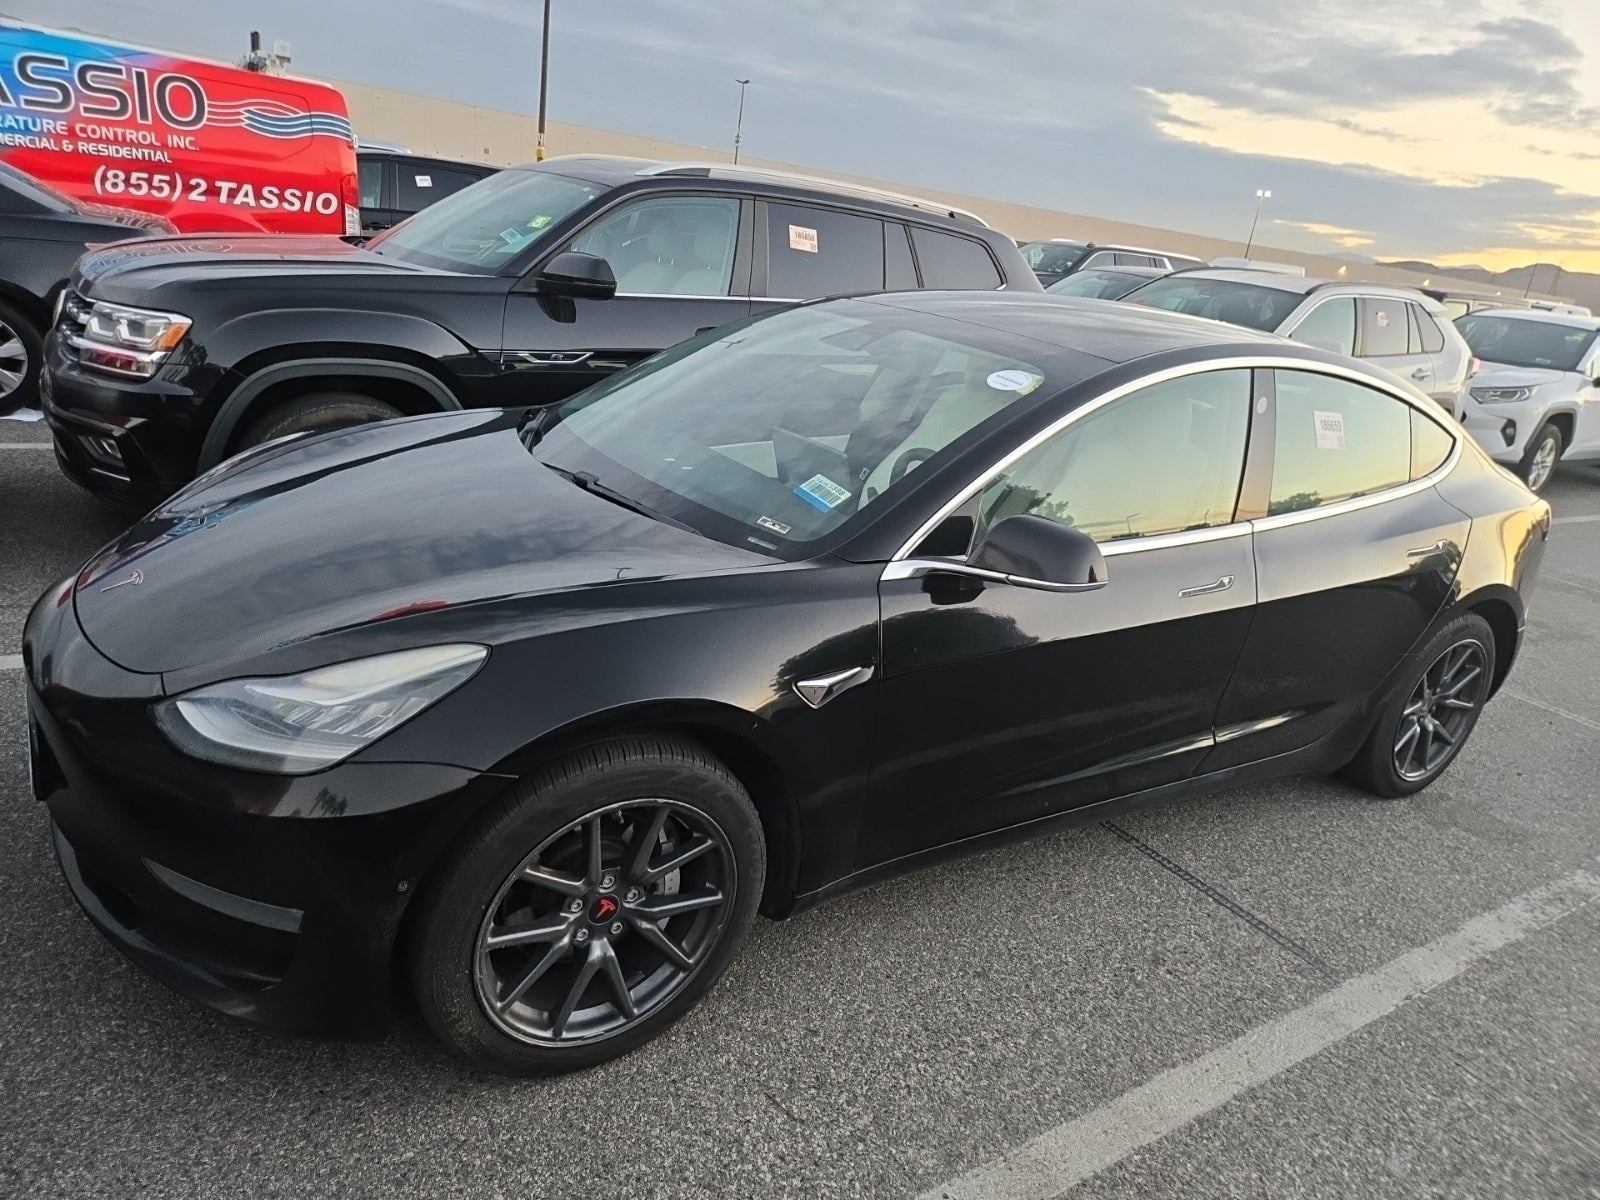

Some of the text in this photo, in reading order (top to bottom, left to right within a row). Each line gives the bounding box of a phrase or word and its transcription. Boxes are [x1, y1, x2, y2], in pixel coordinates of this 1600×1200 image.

[0, 114, 200, 151] ATURE CONTROL INC.
[62, 139, 74, 153] &
[78, 141, 173, 164] RESIDENTIAL
[94, 165, 339, 216] (855) 2 TASSIO
